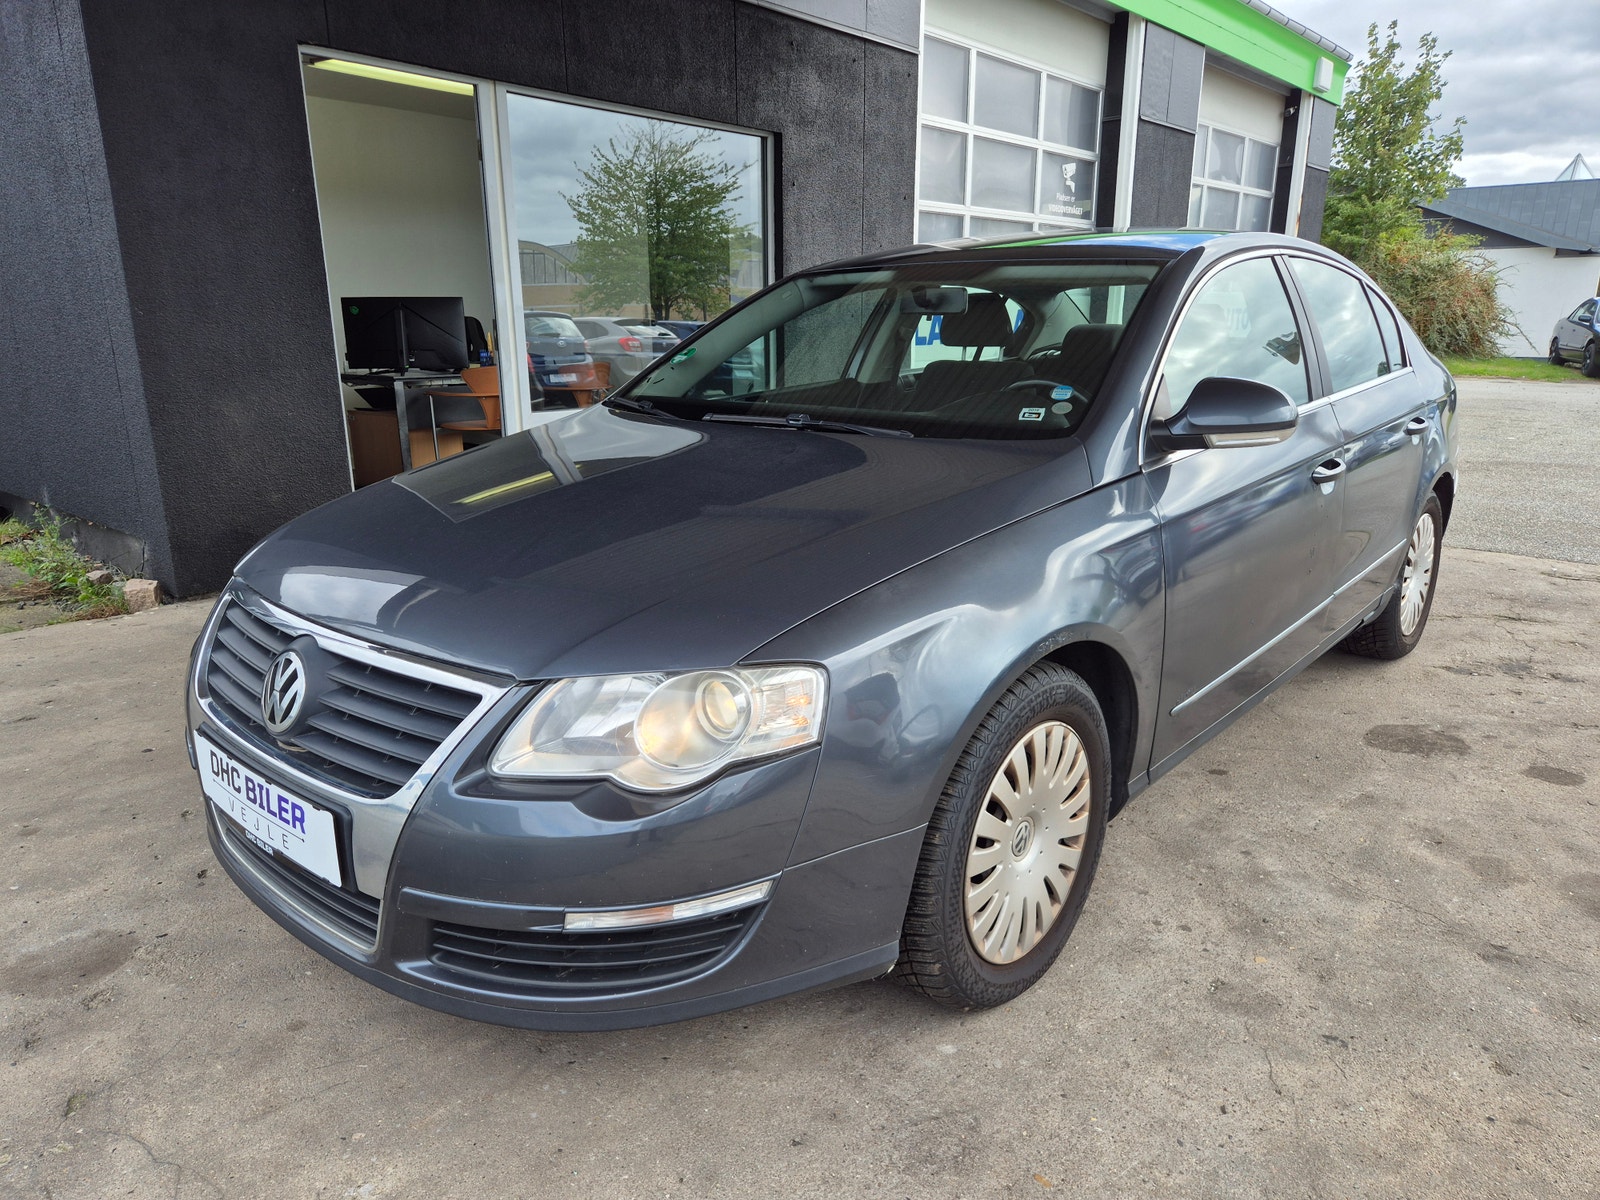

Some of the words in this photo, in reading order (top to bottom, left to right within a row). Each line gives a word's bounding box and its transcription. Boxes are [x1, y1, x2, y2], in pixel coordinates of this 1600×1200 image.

[210, 749, 242, 795] DHC
[244, 774, 306, 835] BILER
[228, 796, 290, 851] VEJLE
